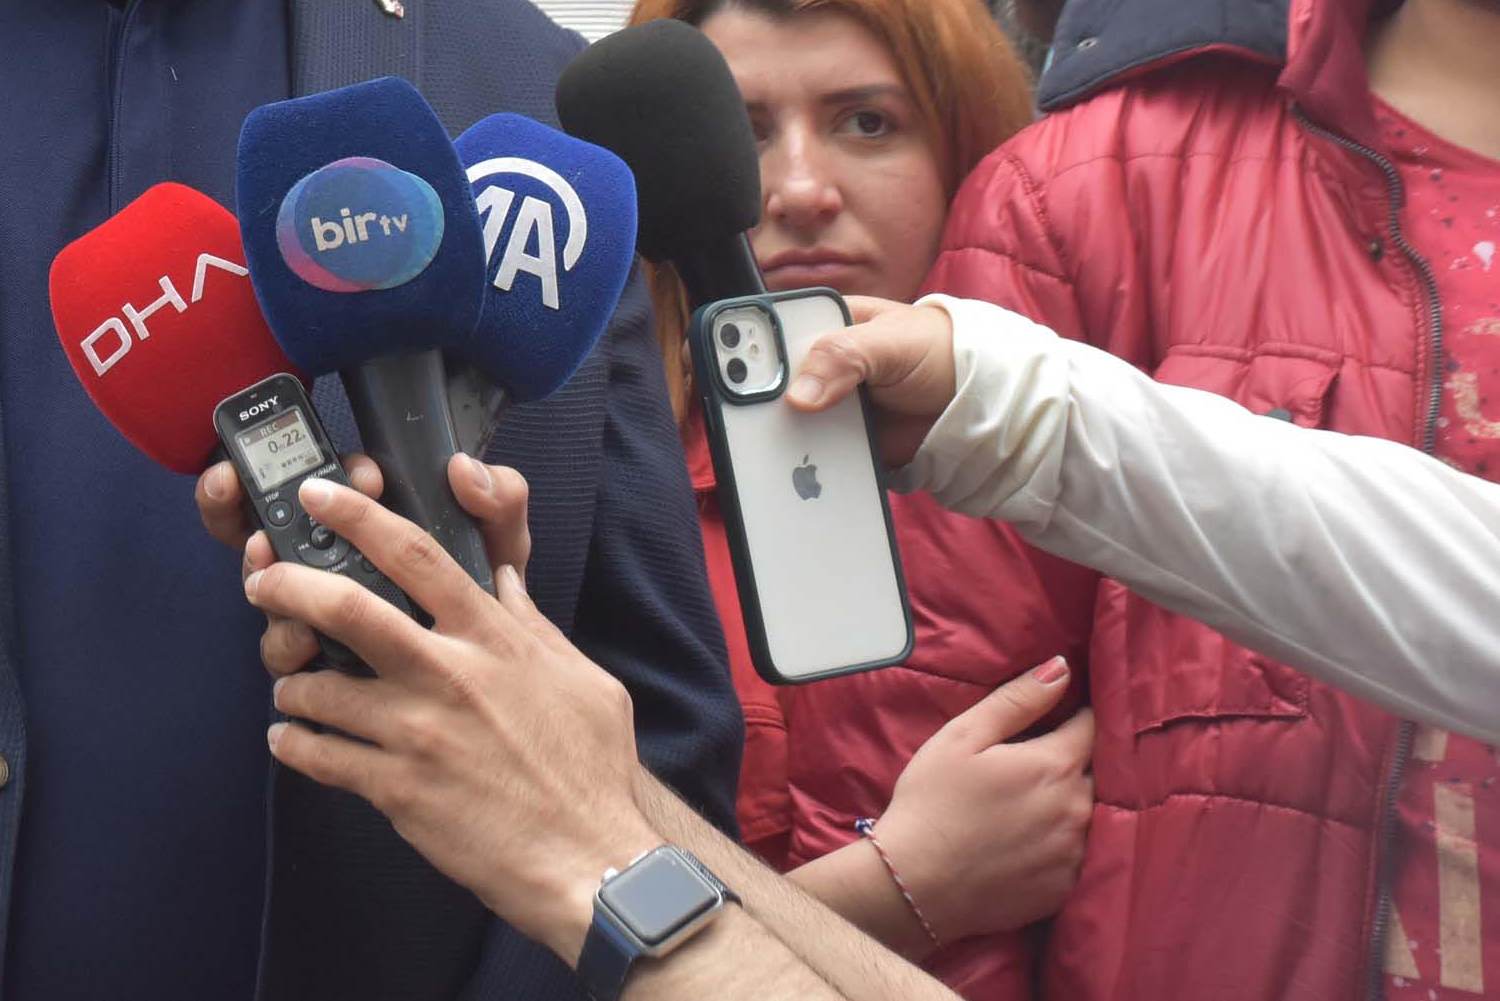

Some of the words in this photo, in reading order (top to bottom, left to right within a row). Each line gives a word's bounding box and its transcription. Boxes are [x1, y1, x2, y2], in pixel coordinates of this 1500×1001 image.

[311, 207, 377, 251] bir
[379, 213, 409, 236] tv
[79, 252, 250, 377] DHA
[238, 394, 279, 422] SONY
